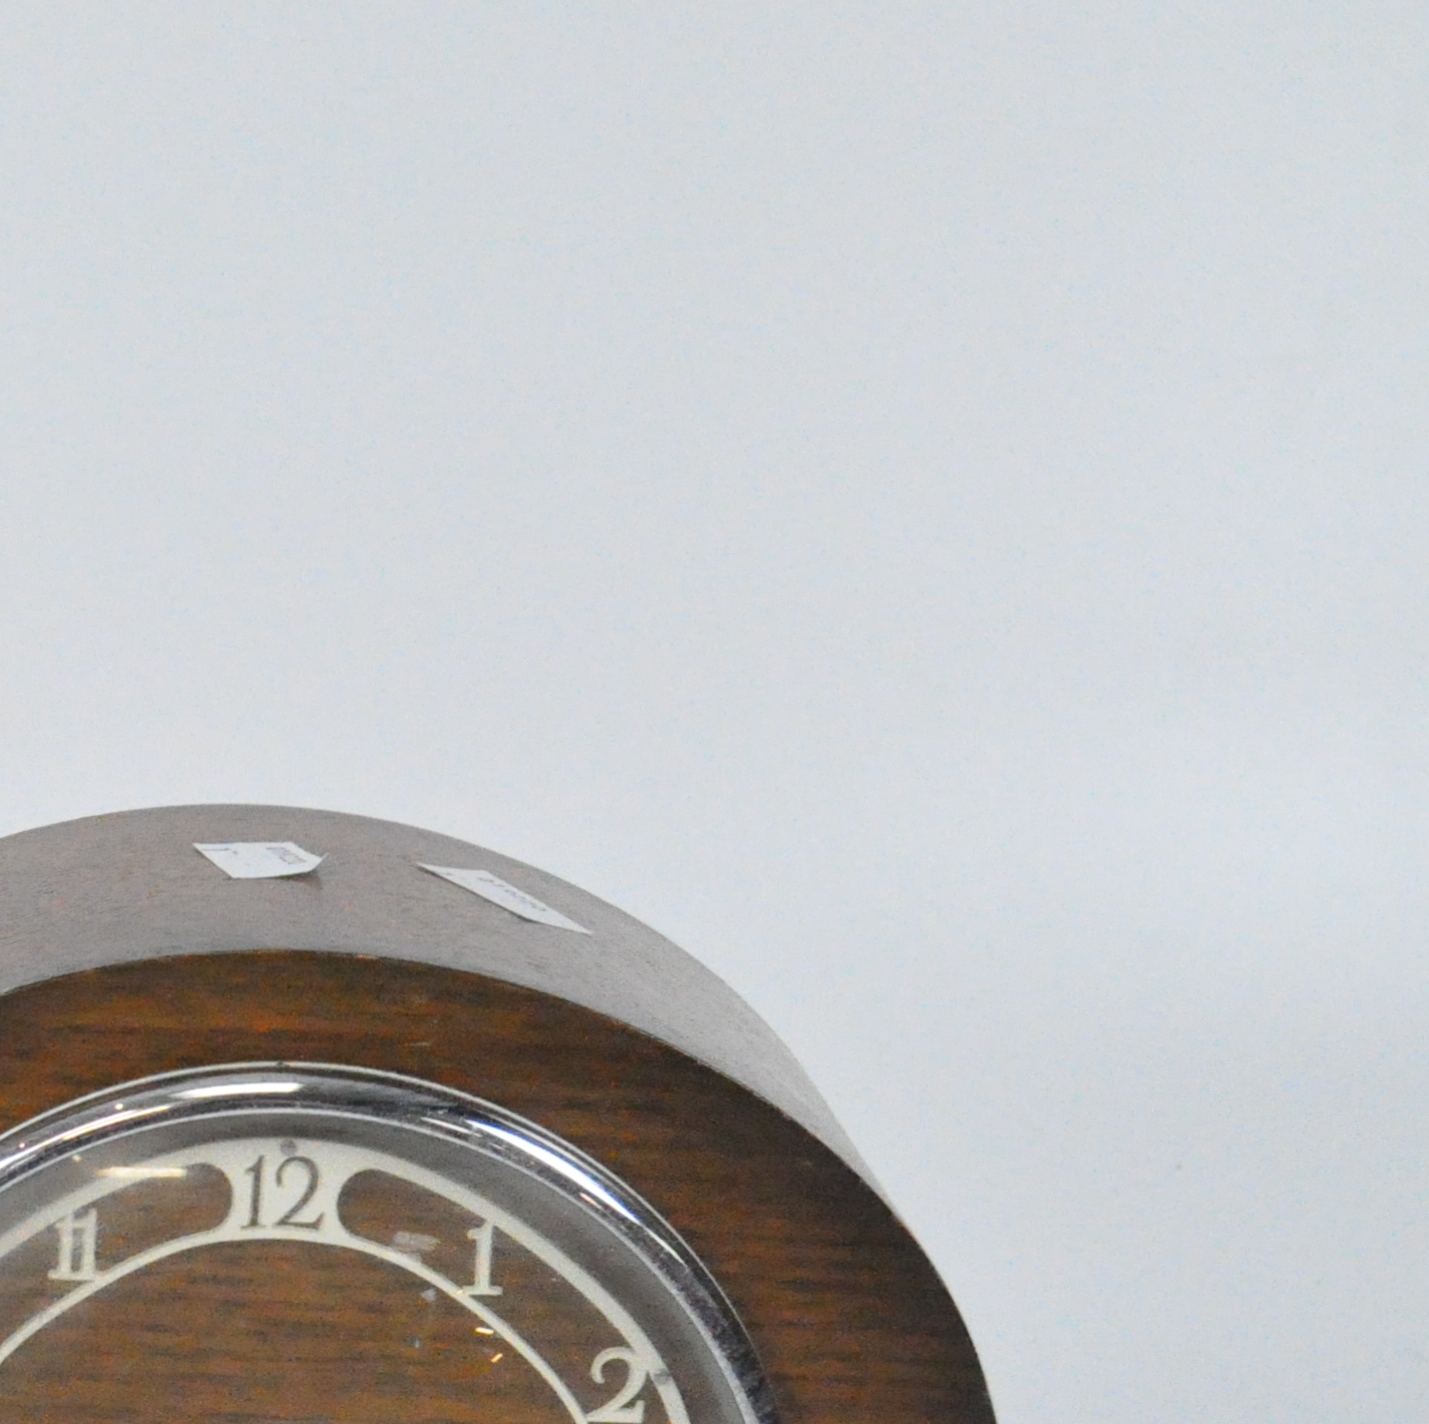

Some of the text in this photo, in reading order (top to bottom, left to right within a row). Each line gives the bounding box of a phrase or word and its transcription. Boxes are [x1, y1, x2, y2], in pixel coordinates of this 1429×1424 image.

[241, 1155, 326, 1230] 12
[48, 1208, 99, 1281] 11
[463, 1220, 503, 1296] 1
[585, 1346, 649, 1424] 2
